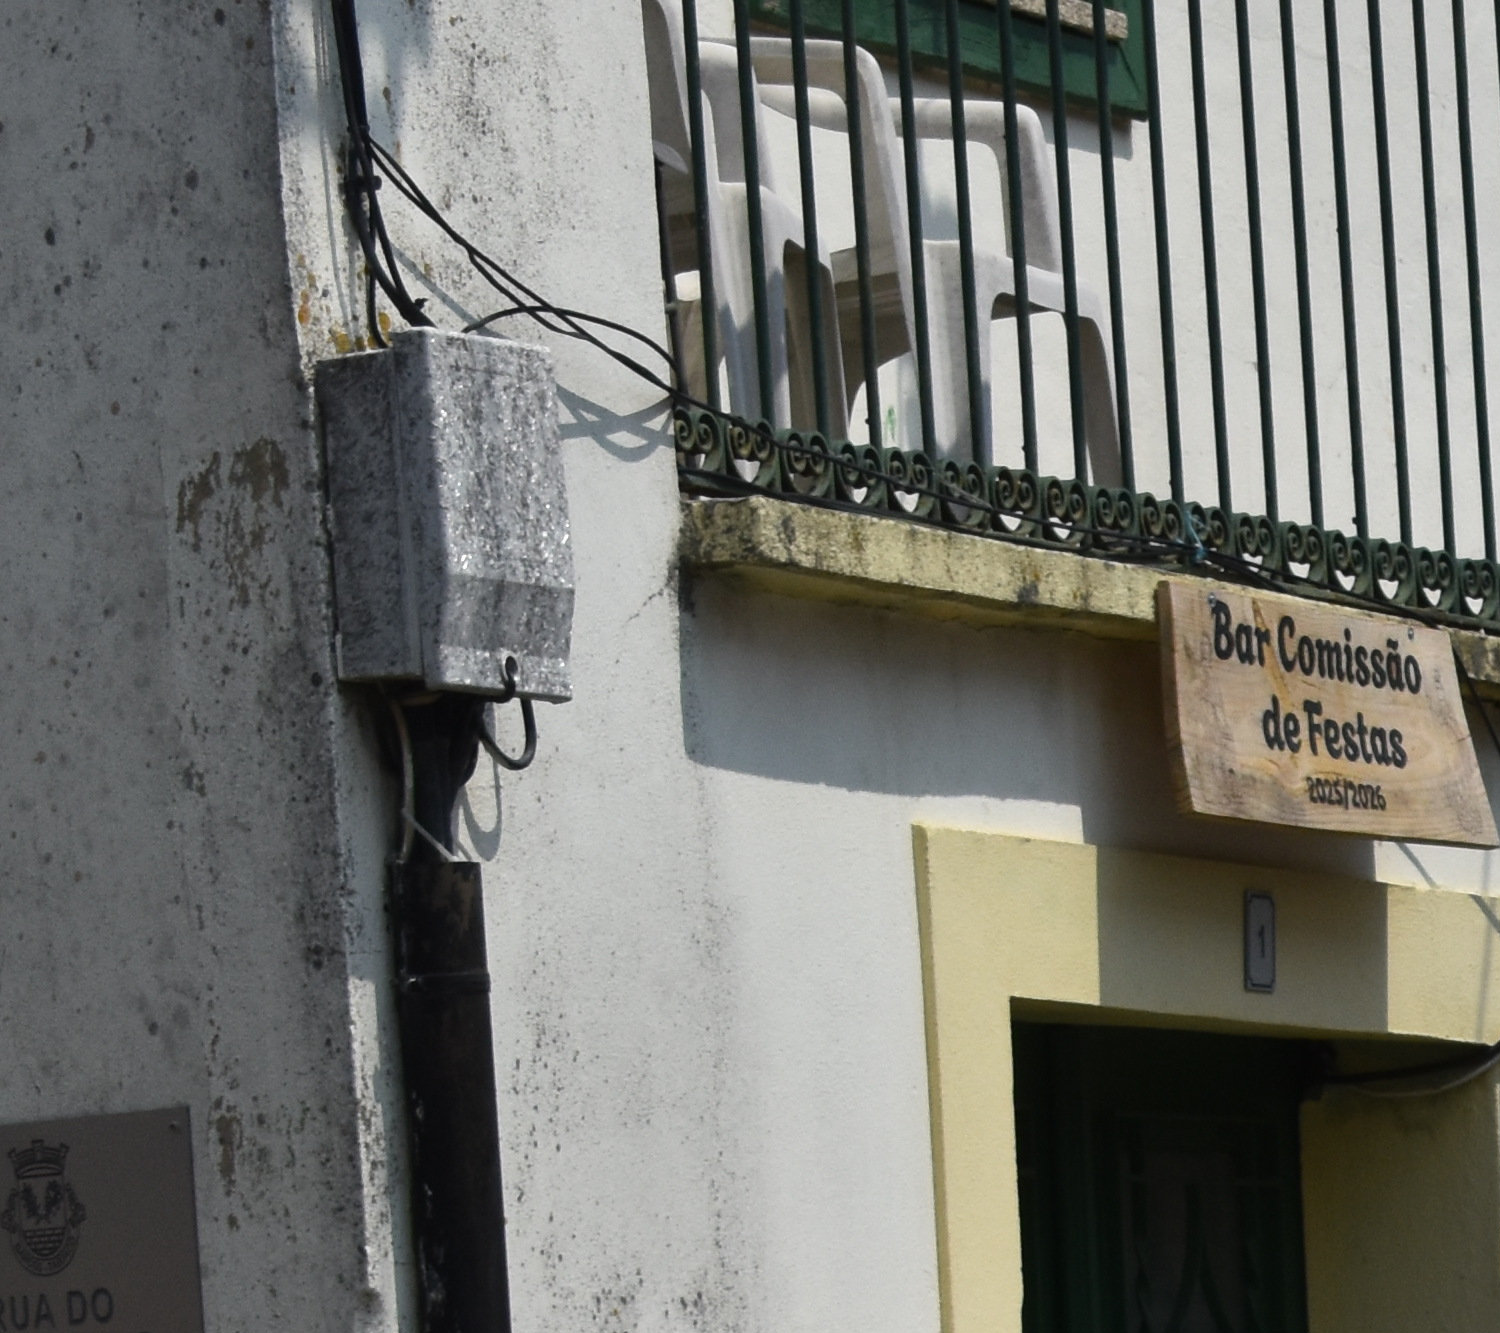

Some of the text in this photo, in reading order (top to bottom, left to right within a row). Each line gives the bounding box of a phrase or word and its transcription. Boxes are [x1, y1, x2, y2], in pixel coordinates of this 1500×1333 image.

[1211, 599, 1422, 695] Bar Comissão
[1262, 694, 1407, 769] de Festas
[1306, 776, 1387, 811] 2025/2026
[0, 1287, 115, 1333] UA DO
